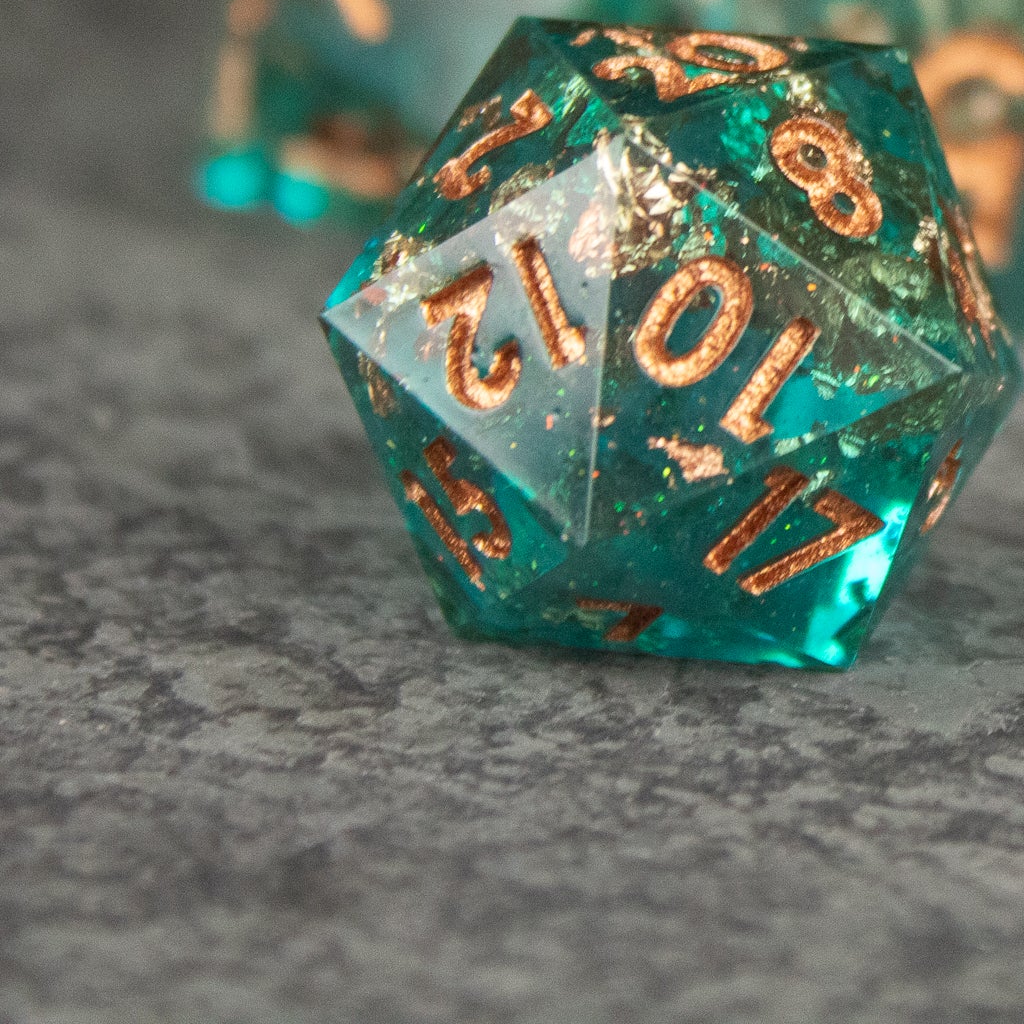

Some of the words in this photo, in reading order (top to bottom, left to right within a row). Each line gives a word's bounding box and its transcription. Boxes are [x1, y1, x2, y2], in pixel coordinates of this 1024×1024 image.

[592, 32, 788, 102] 20
[433, 89, 552, 200] 2
[770, 117, 883, 239] 8
[420, 234, 586, 411] 12
[635, 254, 822, 444] 10
[400, 435, 513, 592] 15
[703, 466, 885, 596] 17
